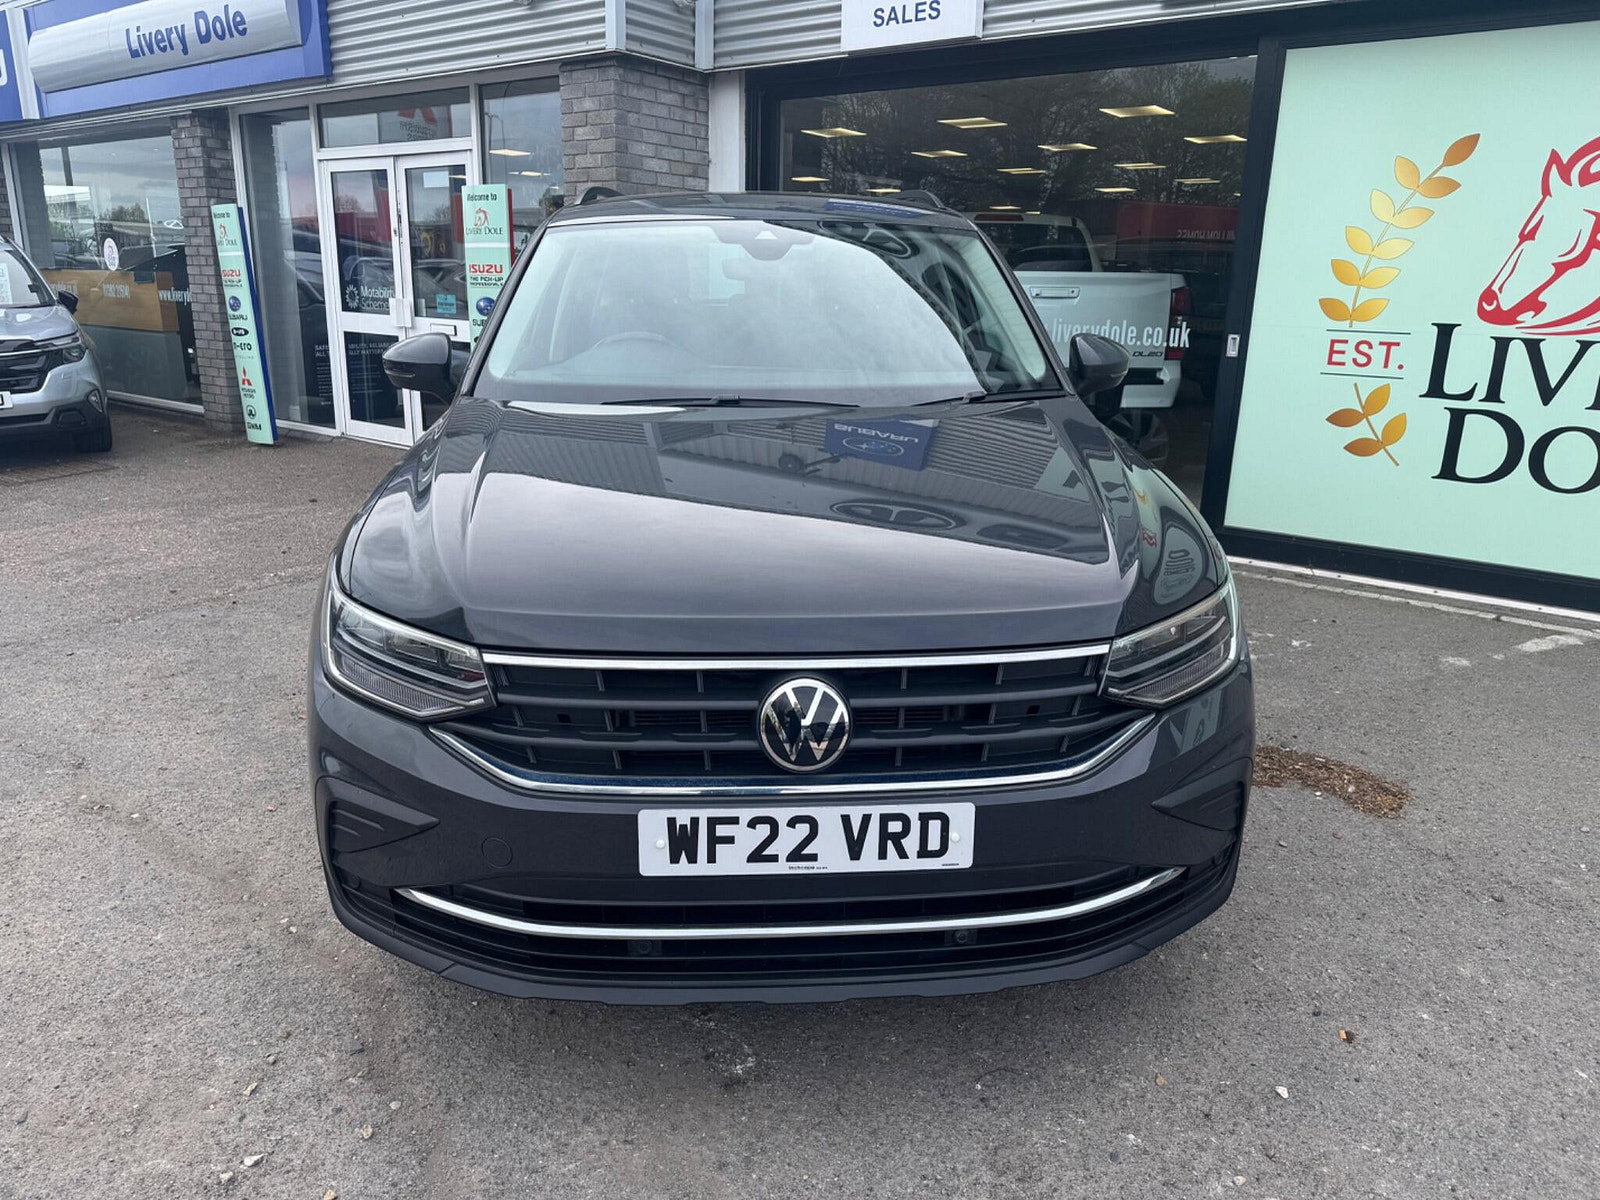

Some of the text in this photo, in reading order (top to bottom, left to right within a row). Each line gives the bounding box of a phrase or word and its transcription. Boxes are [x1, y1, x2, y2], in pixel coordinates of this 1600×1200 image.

[873, 0, 941, 27] SALES
[125, 4, 248, 59] Livery Dole
[490, 193, 497, 202] to
[484, 226, 504, 235] DOLE
[469, 264, 503, 274] ISUZU
[1326, 338, 1404, 371] EST.
[1418, 322, 1600, 411] LIV
[666, 811, 951, 865] WF22 VRD
